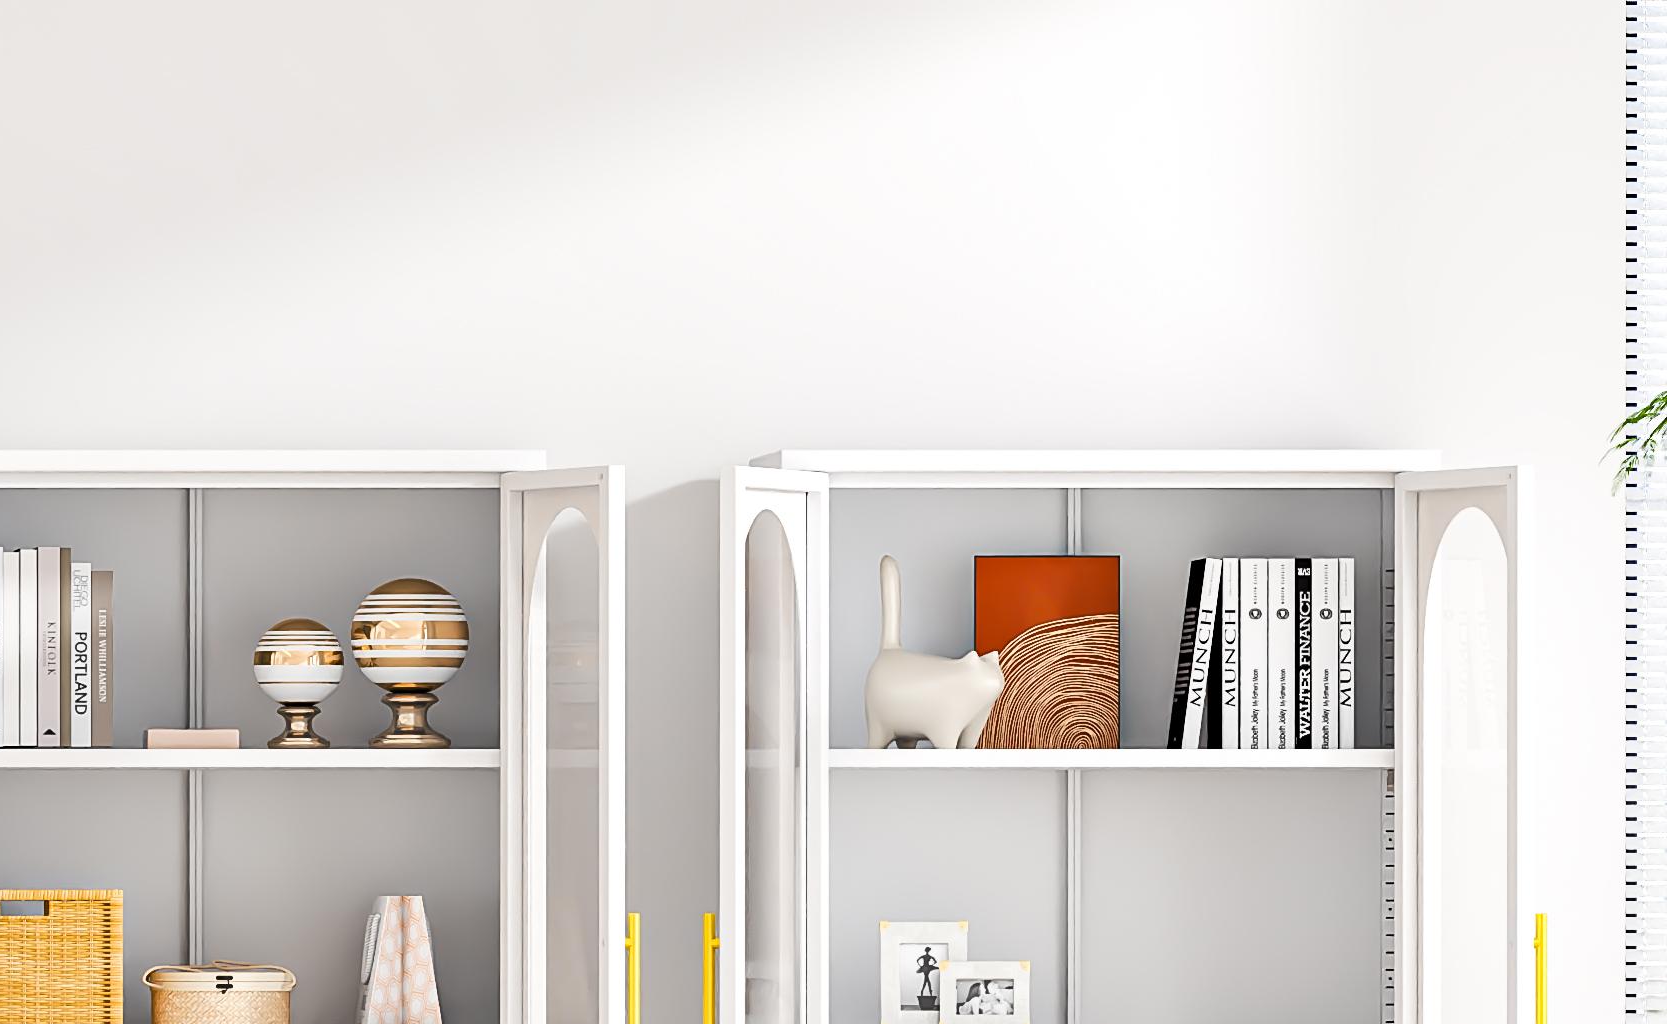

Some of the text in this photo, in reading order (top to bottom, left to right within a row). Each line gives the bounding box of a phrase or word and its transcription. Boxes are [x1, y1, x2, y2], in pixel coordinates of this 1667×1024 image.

[98, 609, 107, 638] LESLIE
[1190, 608, 1214, 707] MUNCH
[1224, 609, 1237, 707] MUNCH
[1299, 591, 1311, 739] WALTER FINANCE
[1339, 609, 1352, 707] MUNCH
[75, 631, 88, 716] PORTLAND
